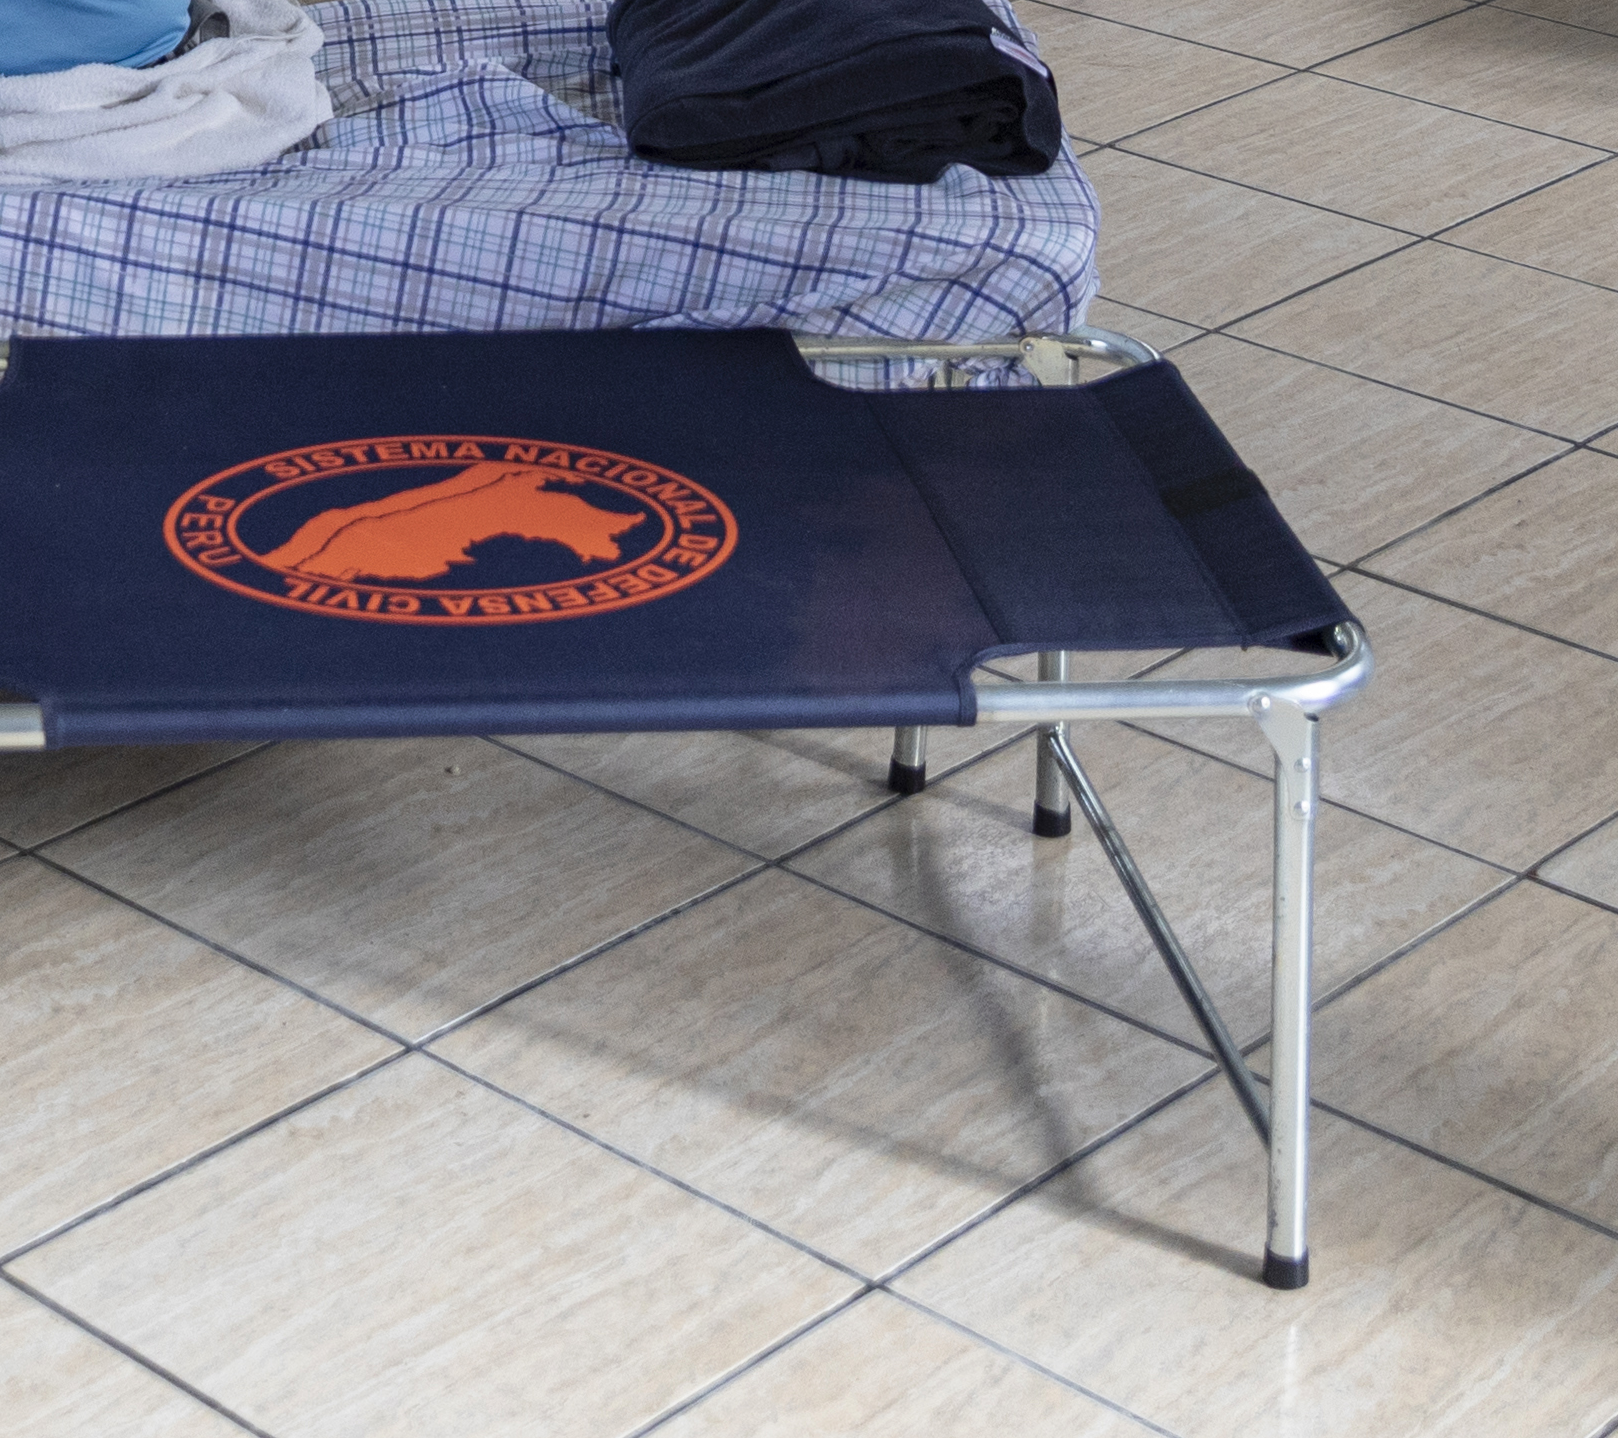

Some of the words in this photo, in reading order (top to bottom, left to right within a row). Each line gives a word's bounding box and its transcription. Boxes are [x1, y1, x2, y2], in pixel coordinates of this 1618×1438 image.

[263, 439, 484, 482] SISTEMA
[504, 439, 717, 530] NACIONAL
[179, 493, 244, 568] PERU
[660, 531, 721, 569] DE
[282, 575, 421, 617] CIVIL
[447, 562, 682, 618] DEFENSA
